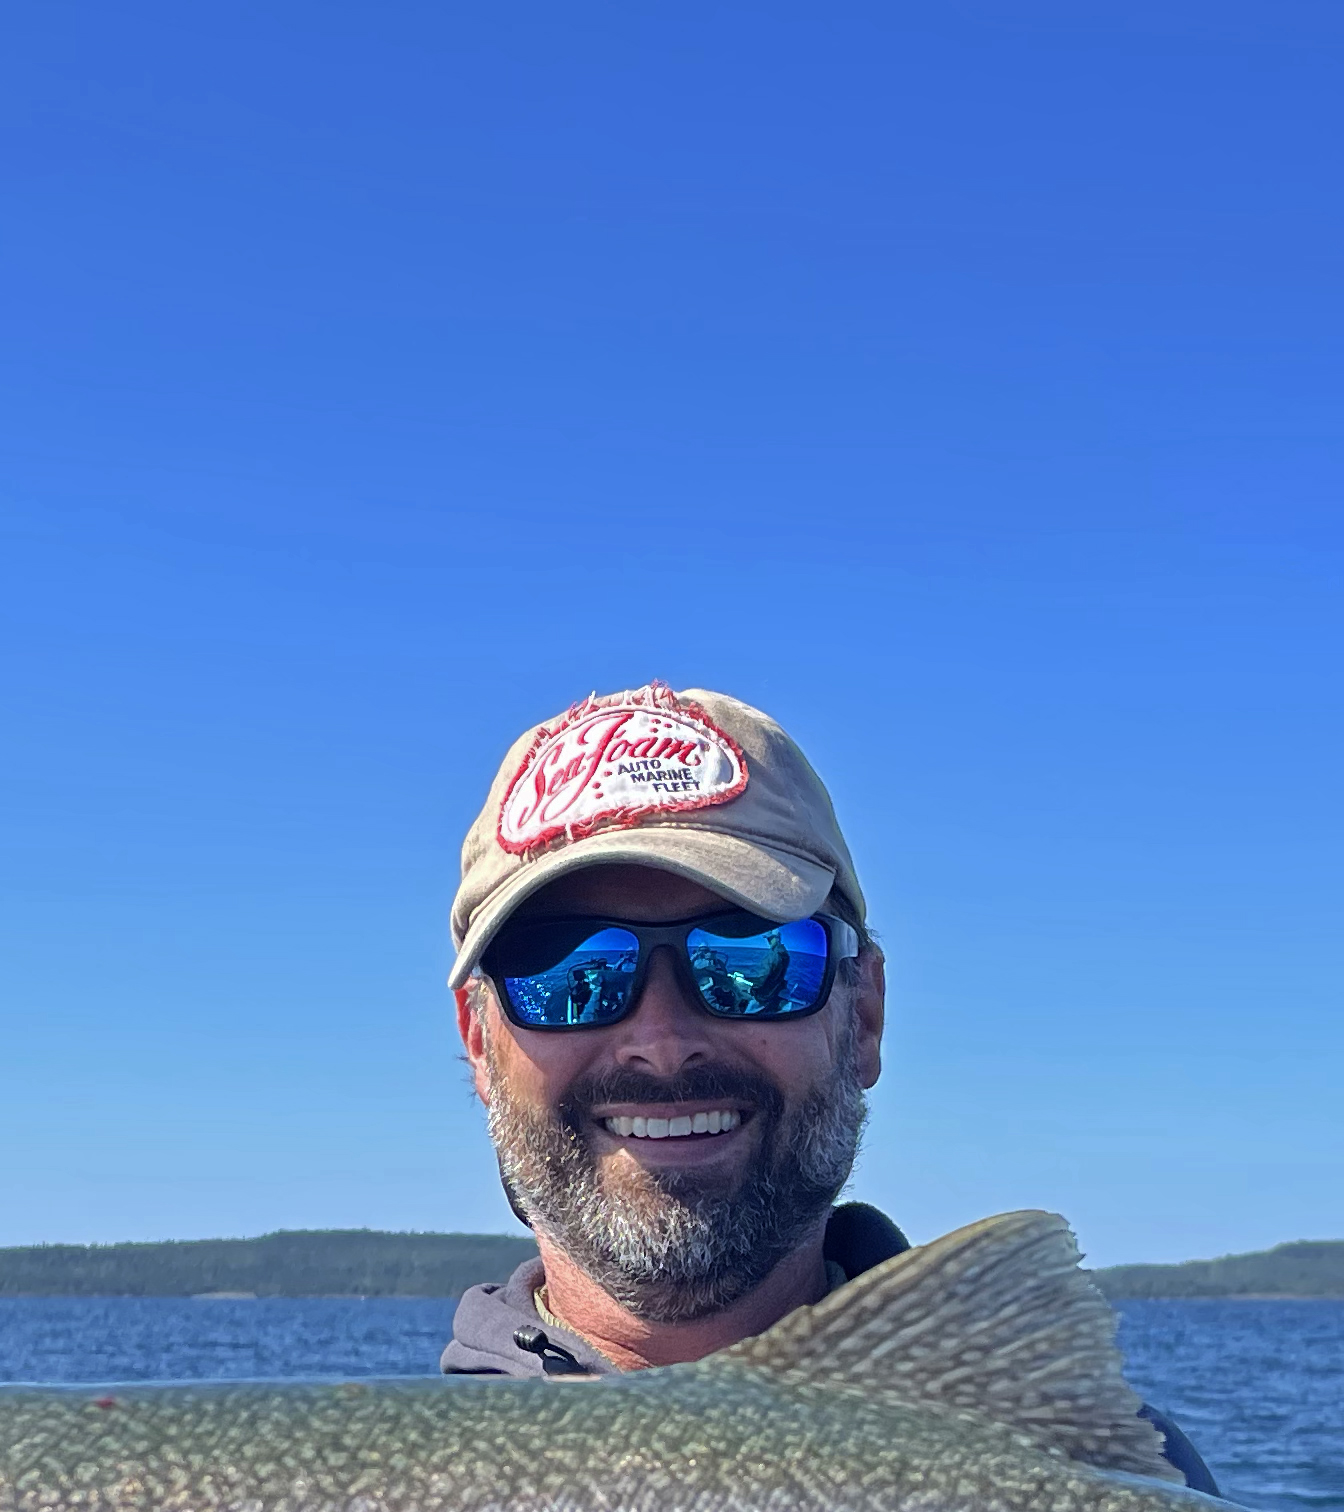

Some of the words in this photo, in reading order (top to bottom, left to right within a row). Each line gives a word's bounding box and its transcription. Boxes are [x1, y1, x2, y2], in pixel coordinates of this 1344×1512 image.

[617, 759, 662, 776] AUTO
[630, 767, 694, 784] MARINE
[651, 780, 701, 793] FLEET
